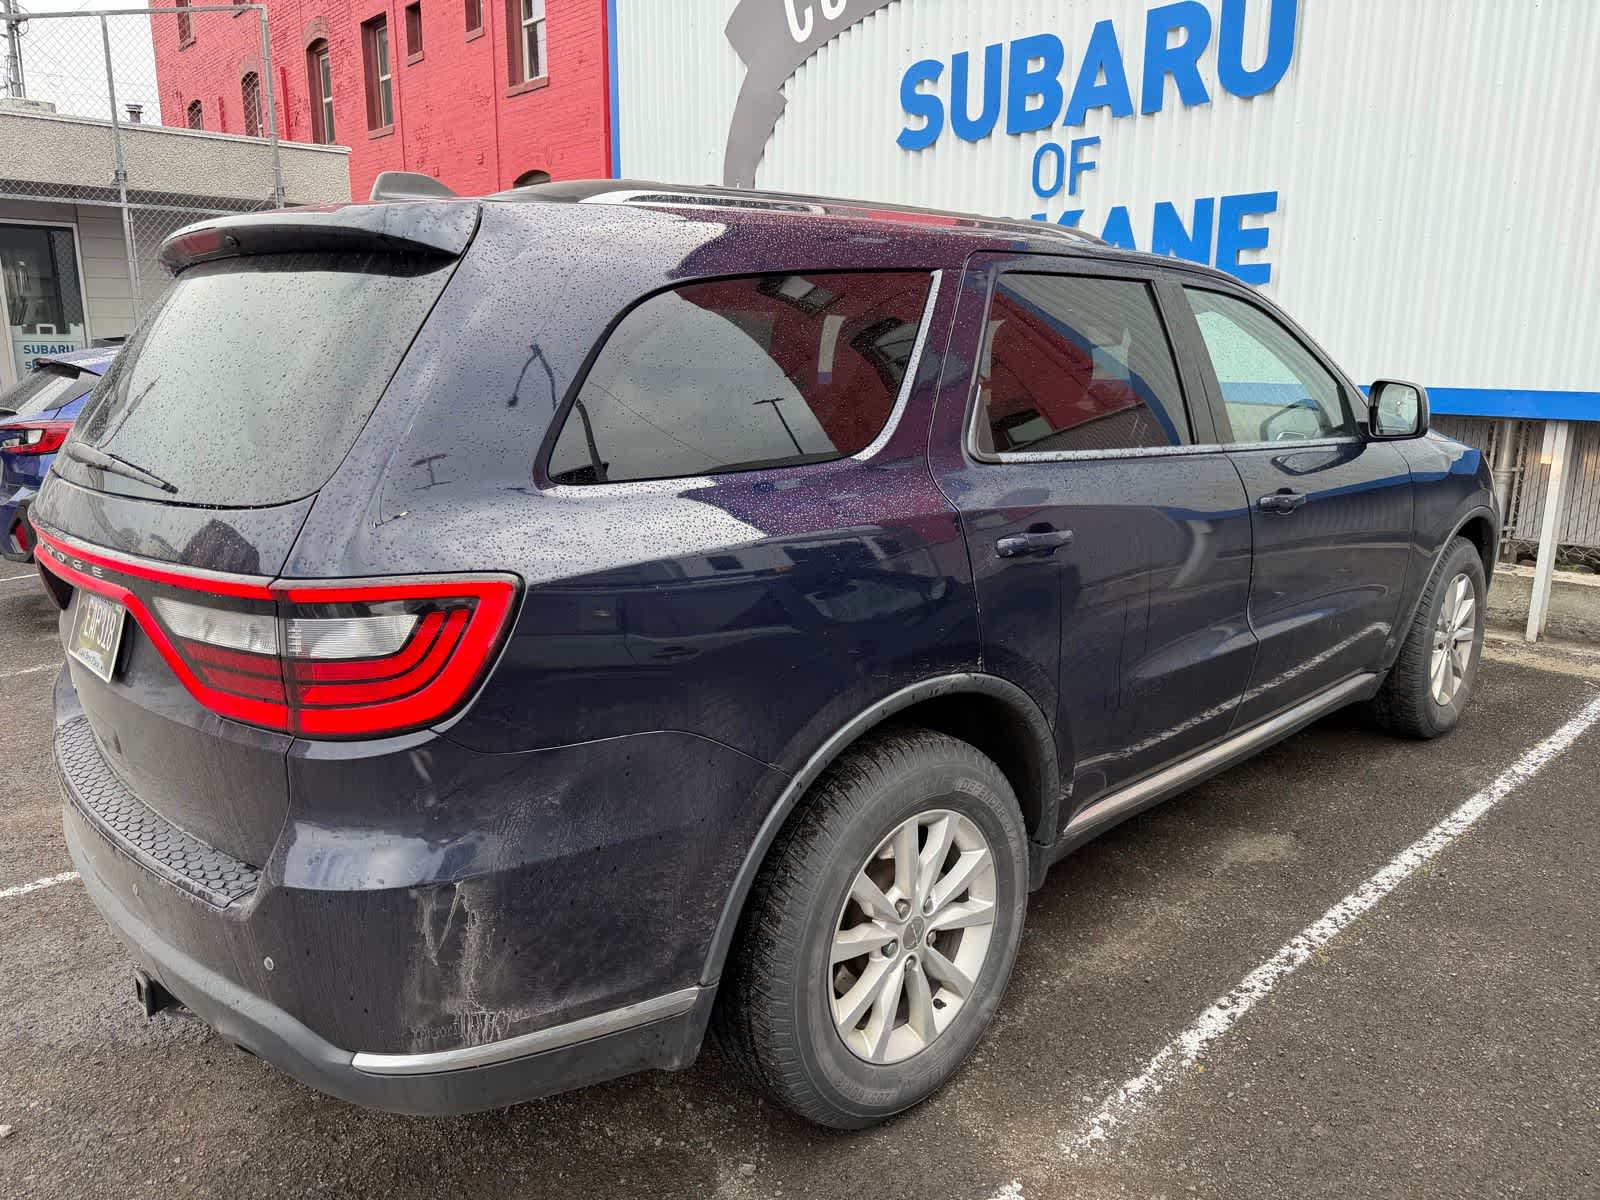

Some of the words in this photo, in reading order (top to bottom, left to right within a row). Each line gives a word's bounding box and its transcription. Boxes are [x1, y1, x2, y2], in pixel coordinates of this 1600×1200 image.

[896, 0, 1298, 152] SUBARU
[1031, 136, 1101, 199] OF
[1031, 191, 1278, 286] ANE
[23, 344, 75, 355] SUBARU
